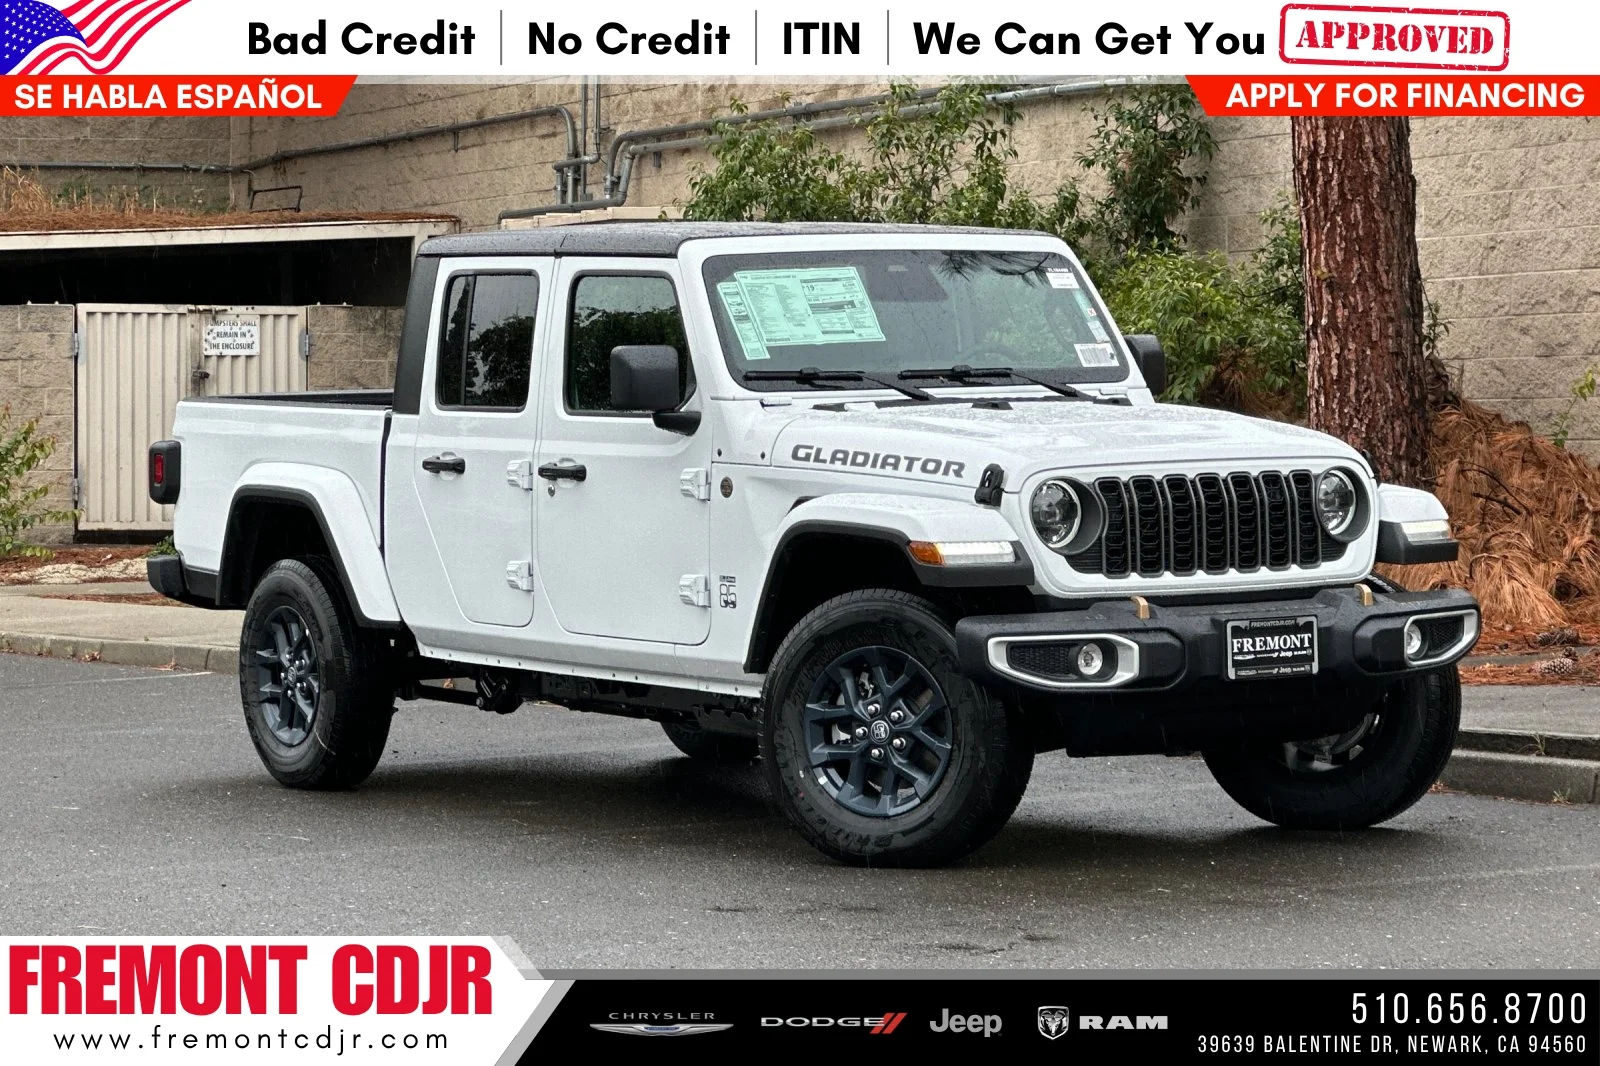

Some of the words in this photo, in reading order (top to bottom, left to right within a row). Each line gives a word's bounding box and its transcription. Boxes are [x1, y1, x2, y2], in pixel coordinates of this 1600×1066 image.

[791, 444, 966, 479] GLADIATOR
[1232, 633, 1312, 652] FREMONT
[1280, 650, 1293, 658] Jeep
